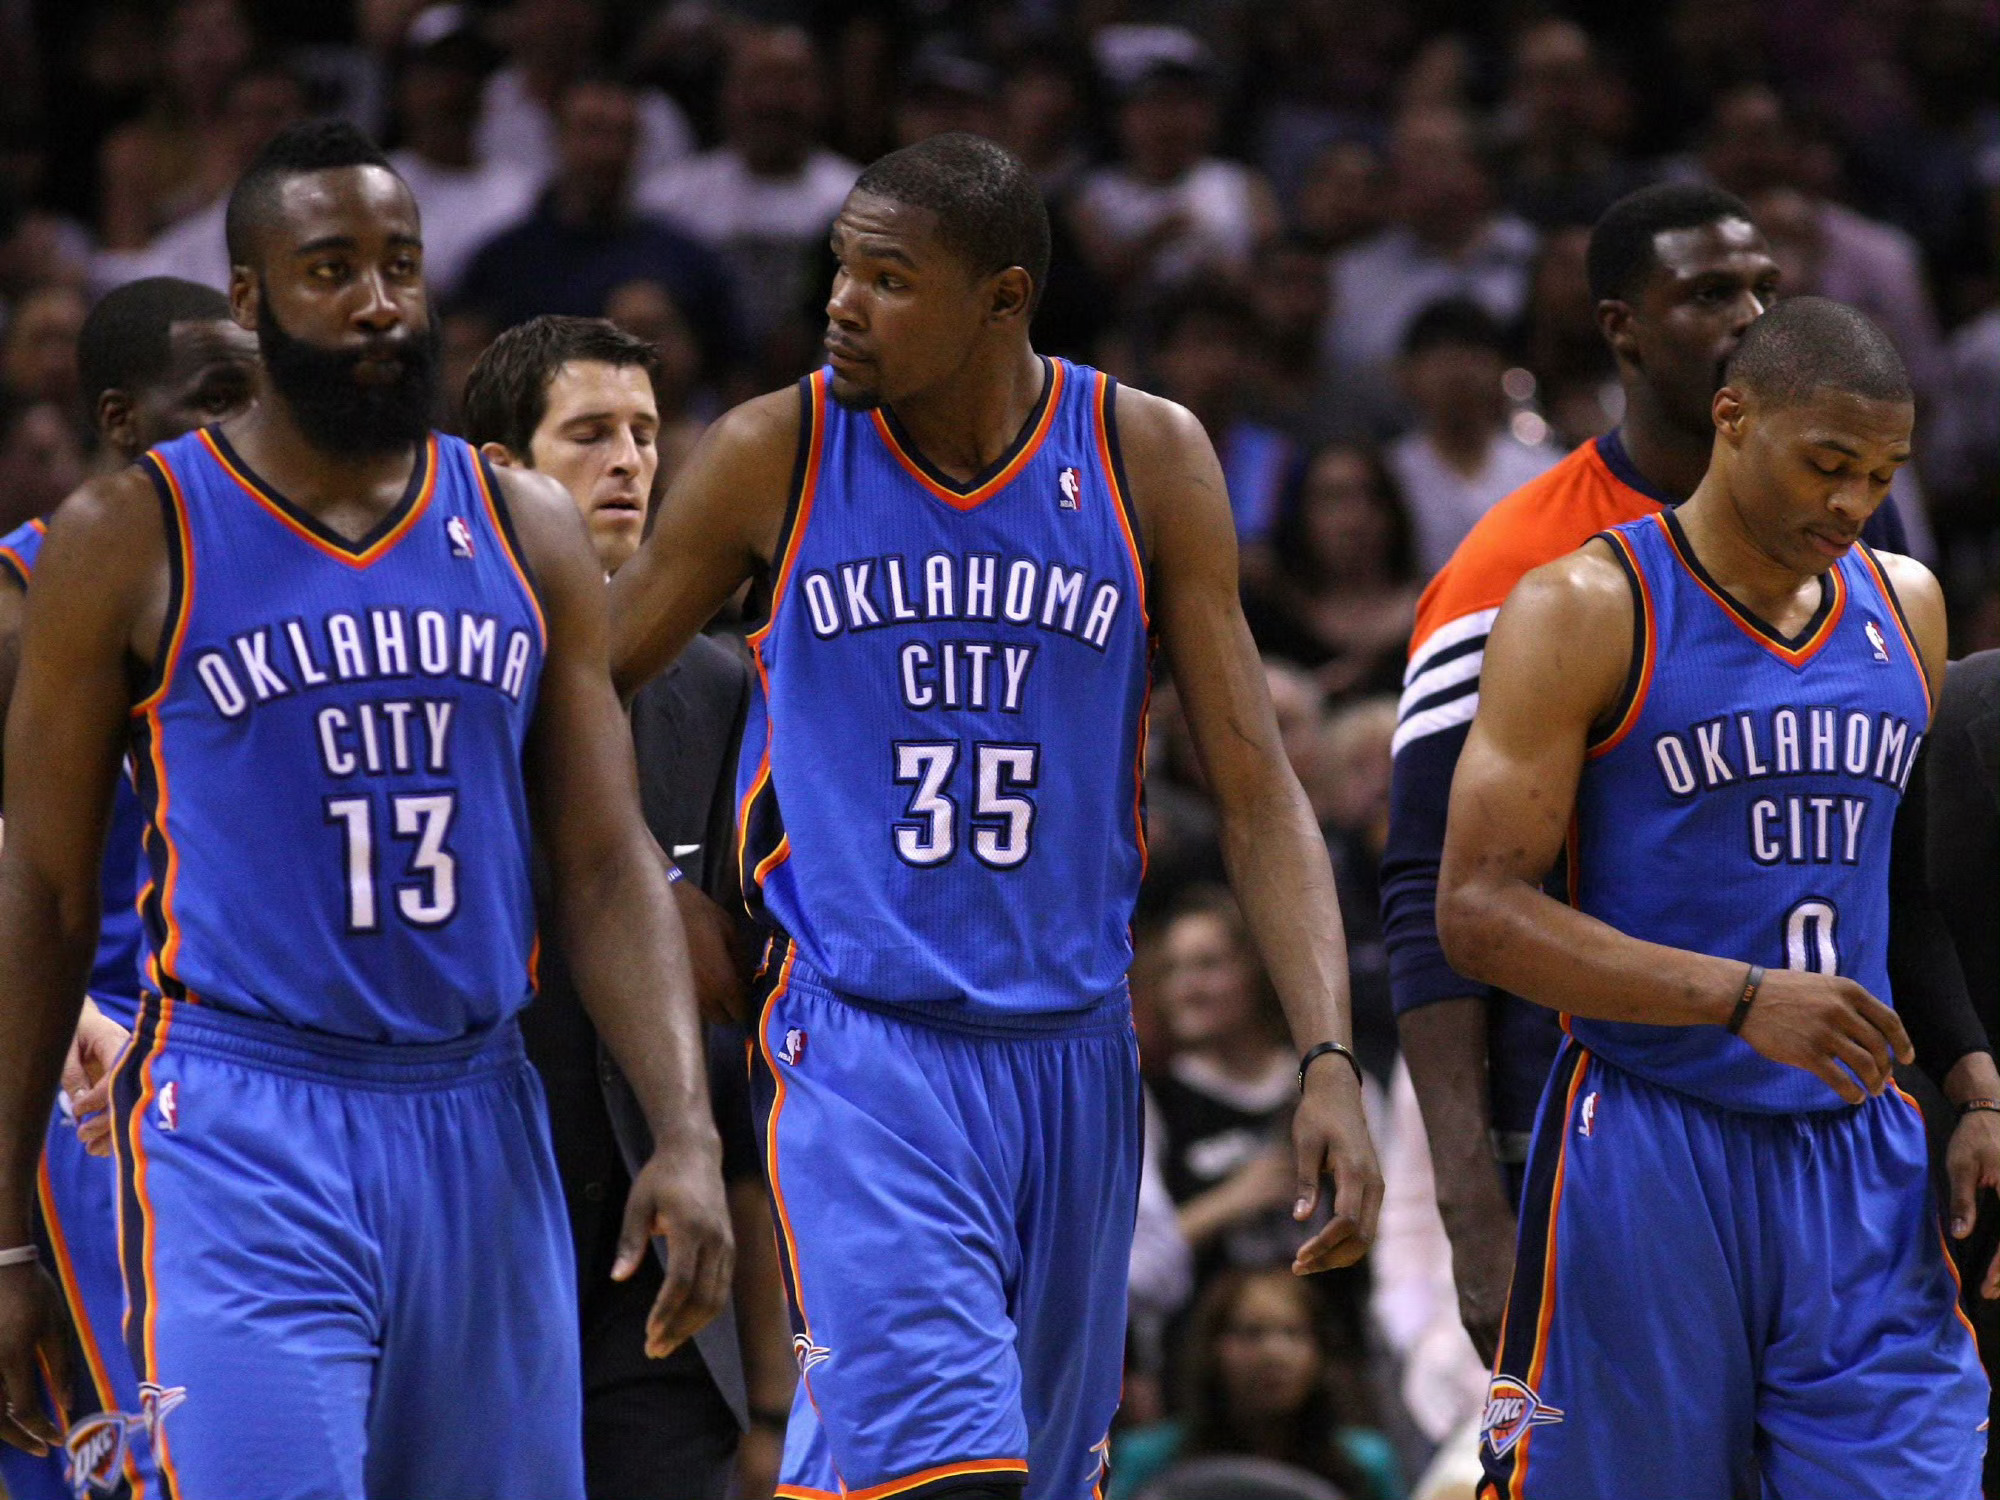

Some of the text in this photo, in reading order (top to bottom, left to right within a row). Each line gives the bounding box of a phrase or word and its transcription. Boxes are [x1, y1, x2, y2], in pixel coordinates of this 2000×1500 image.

[803, 552, 1122, 650] OKLAHOMA
[196, 608, 532, 719] OKLAHOMA
[900, 642, 1033, 711] CITY
[316, 700, 453, 777] CITY
[894, 741, 1037, 868] 35
[1751, 796, 1867, 863] CITY
[326, 792, 459, 931] 13
[1785, 900, 1838, 976] 0
